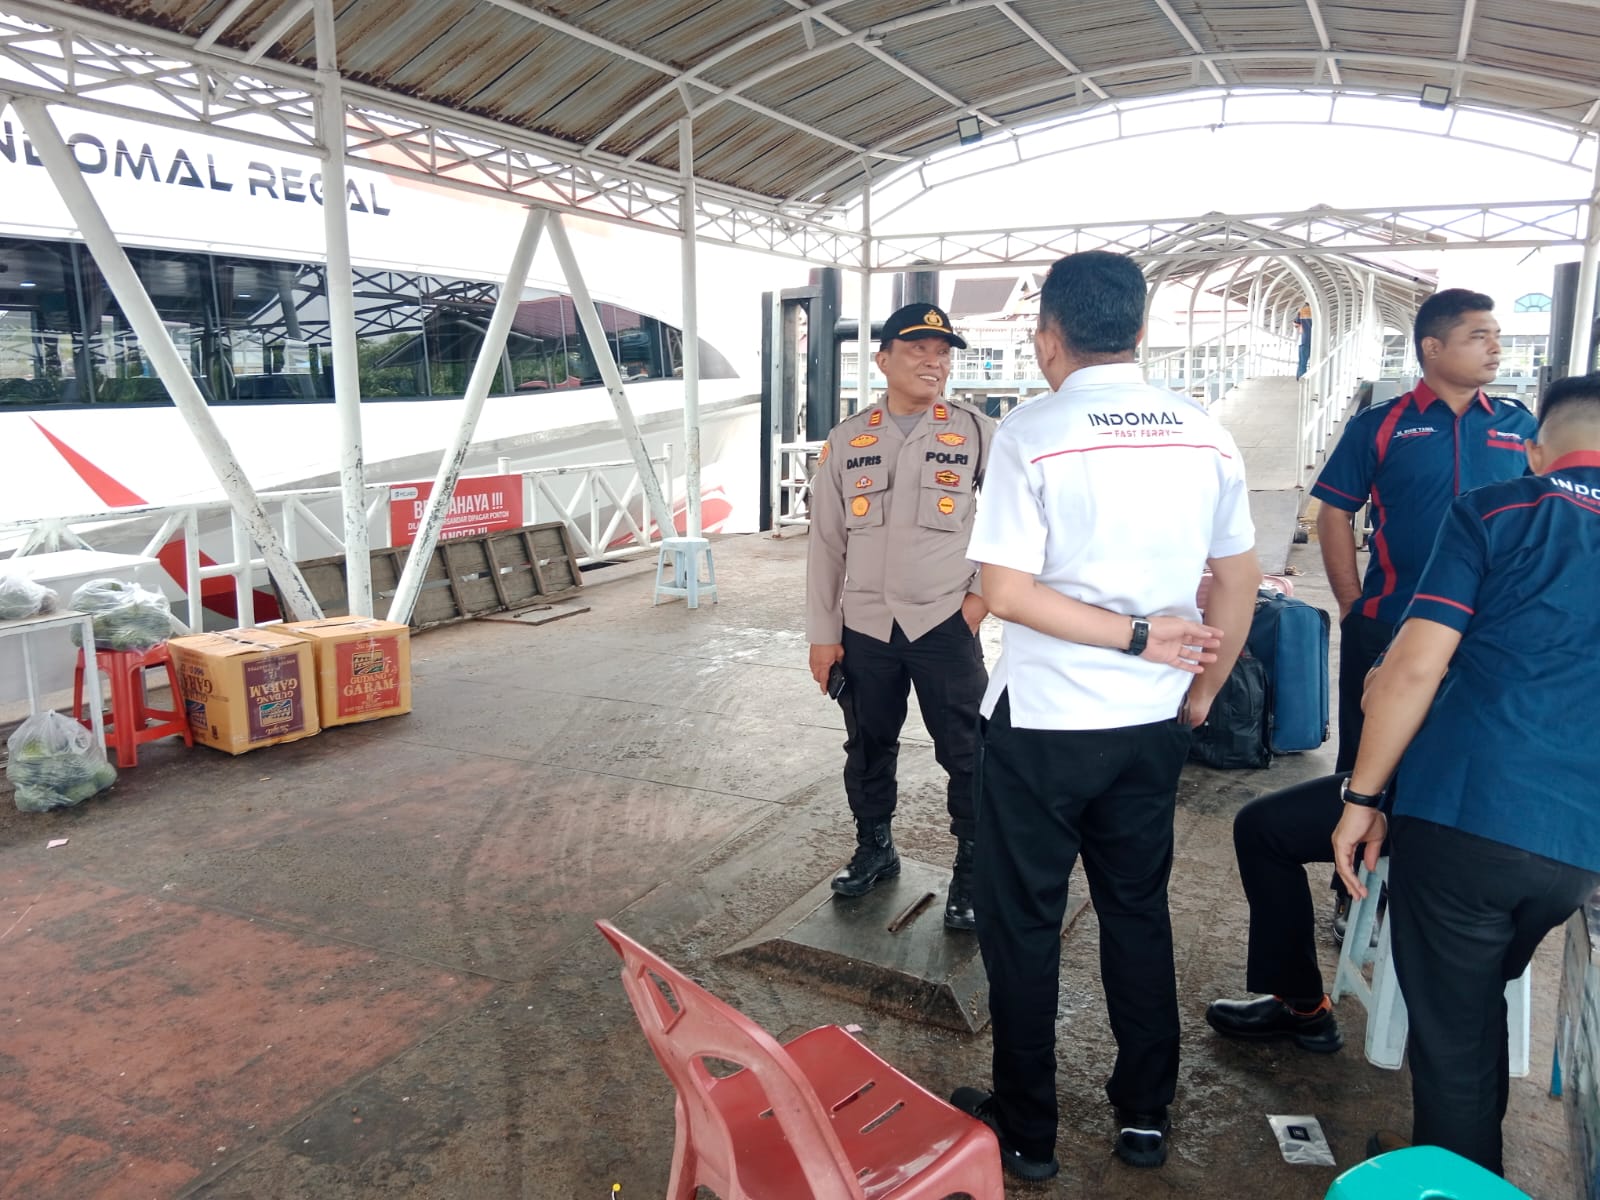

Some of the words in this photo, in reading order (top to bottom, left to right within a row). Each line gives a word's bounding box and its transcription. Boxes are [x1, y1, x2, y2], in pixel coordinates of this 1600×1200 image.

[1088, 412, 1184, 426] INDOMAL
[1114, 430, 1136, 438] FAST
[1141, 429, 1170, 438] FERRY
[847, 455, 882, 470] DAFRIS
[926, 451, 968, 465] POLRI
[413, 493, 489, 519] BAHAYA
[350, 672, 387, 685] GUDANG
[249, 678, 298, 698] GARAM
[343, 678, 394, 697] GARAM
[256, 690, 294, 704] GUDANG
